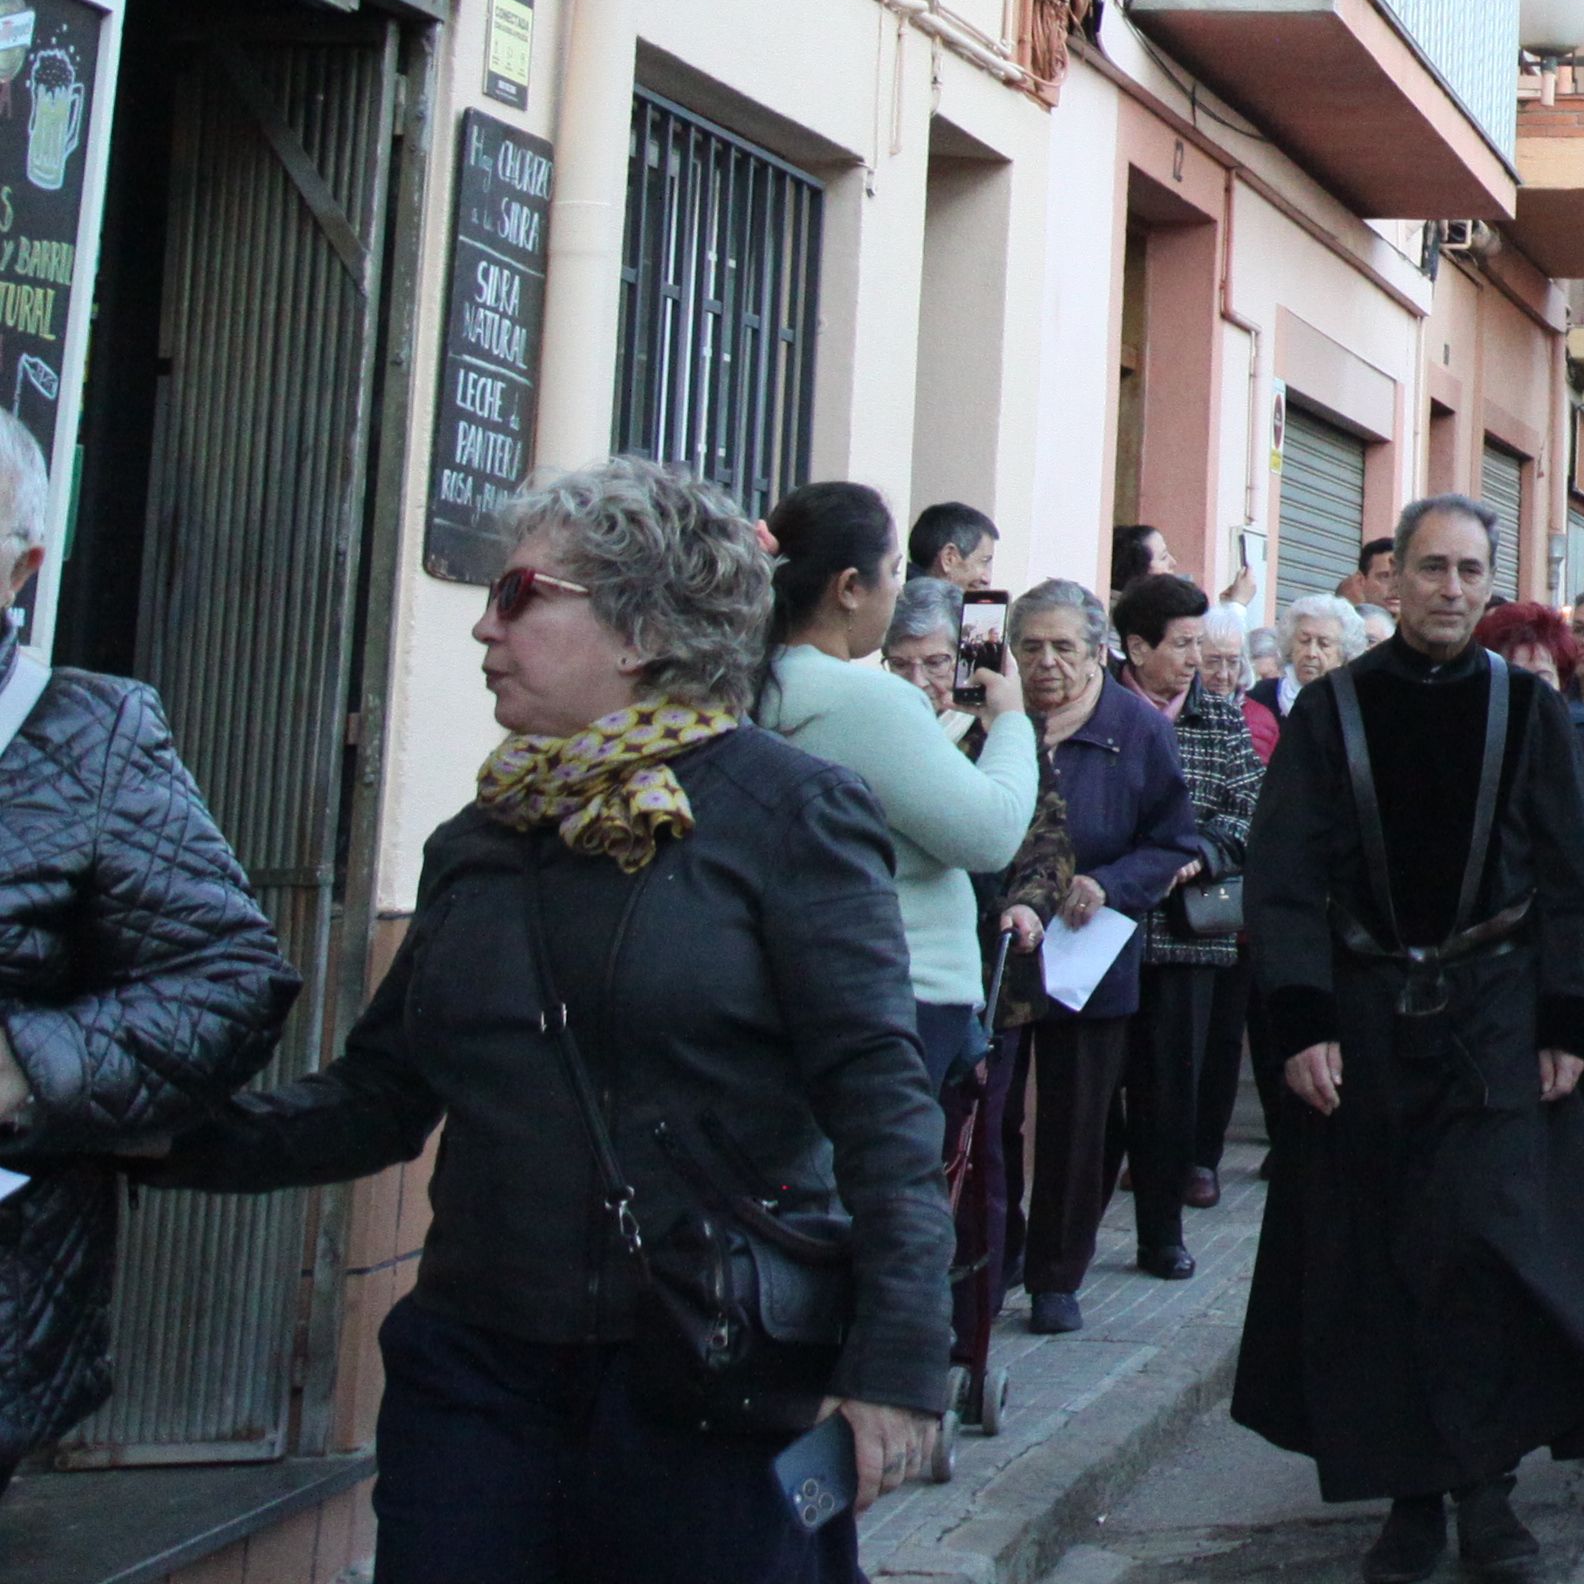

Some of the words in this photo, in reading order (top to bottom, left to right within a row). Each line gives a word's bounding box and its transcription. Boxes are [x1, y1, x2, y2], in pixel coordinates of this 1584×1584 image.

[0, 281, 56, 341] TURAL
[475, 260, 521, 318] SIDRA
[463, 302, 528, 370] NATURAL
[456, 368, 506, 423] LECHE
[455, 420, 522, 482] PANTERA
